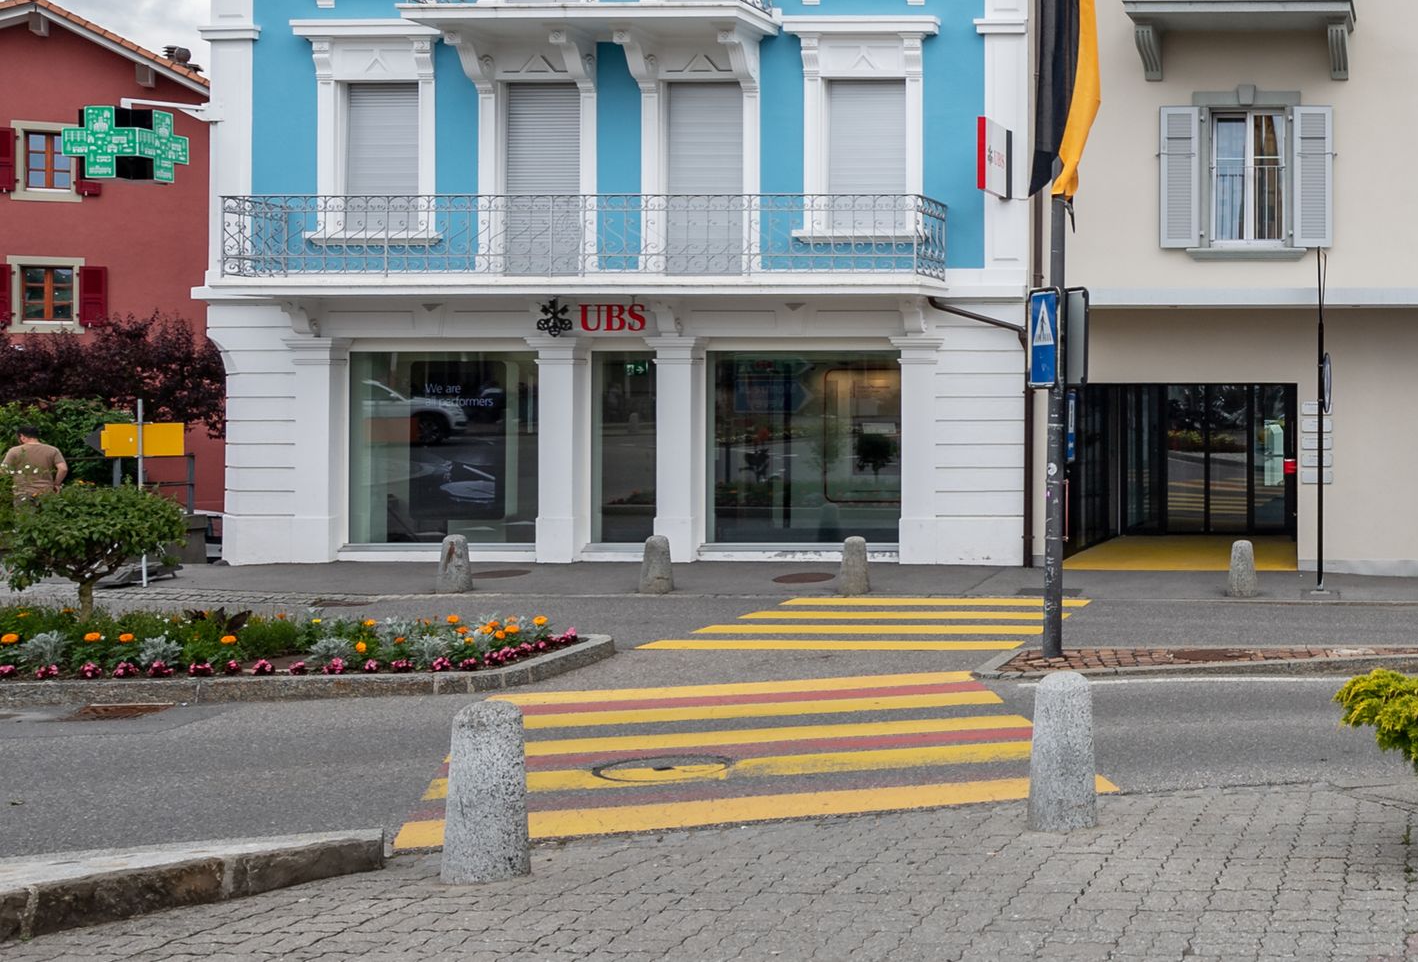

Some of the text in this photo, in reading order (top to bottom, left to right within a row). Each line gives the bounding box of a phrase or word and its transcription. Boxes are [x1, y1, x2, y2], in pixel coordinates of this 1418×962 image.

[579, 303, 646, 332] UBS
[425, 383, 461, 394] We are
[425, 396, 494, 410] all performers
